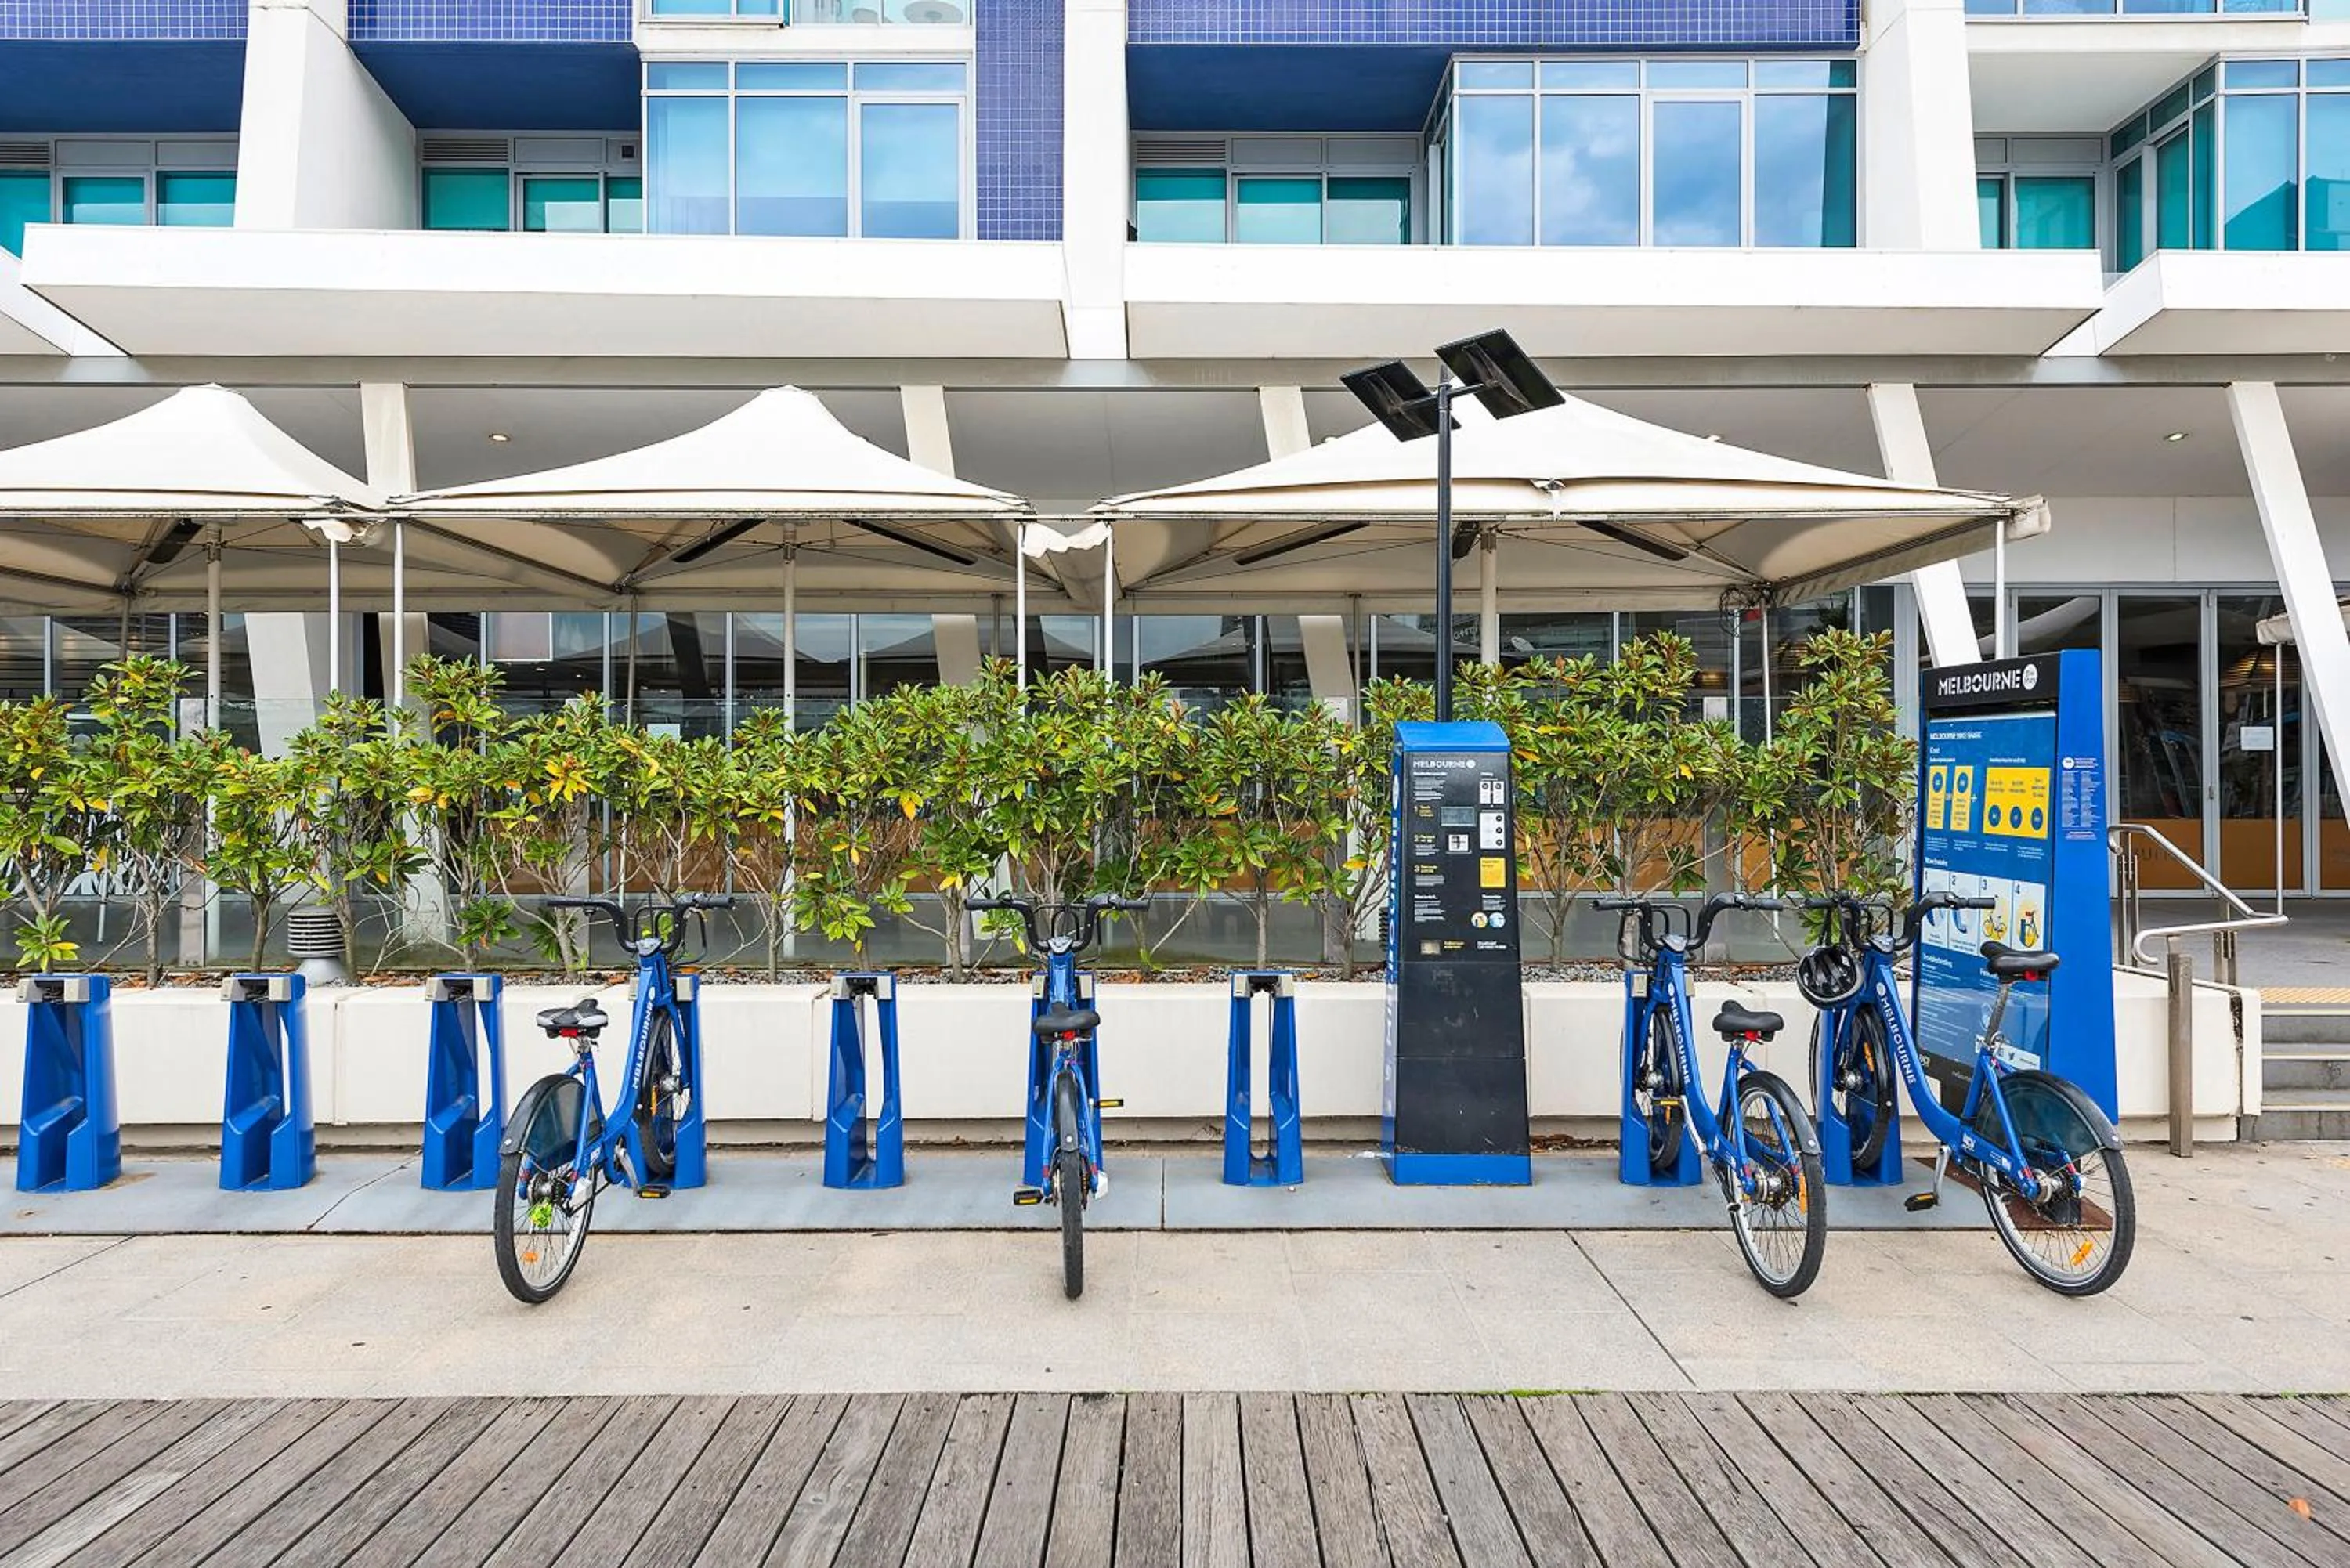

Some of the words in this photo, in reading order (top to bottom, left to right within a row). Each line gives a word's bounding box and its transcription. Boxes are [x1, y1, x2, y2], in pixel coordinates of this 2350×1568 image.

[1937, 670, 2022, 695] MELBOURNE
[1413, 760, 1466, 768] MELBOURNE
[1951, 875, 1956, 886] 2
[1981, 879, 1987, 891] 3
[2015, 884, 2021, 894] 4
[632, 1001, 653, 1089] MELBOURNE
[1669, 997, 1691, 1084] MELBOURNE
[1880, 996, 1917, 1084] MELBOURNE
